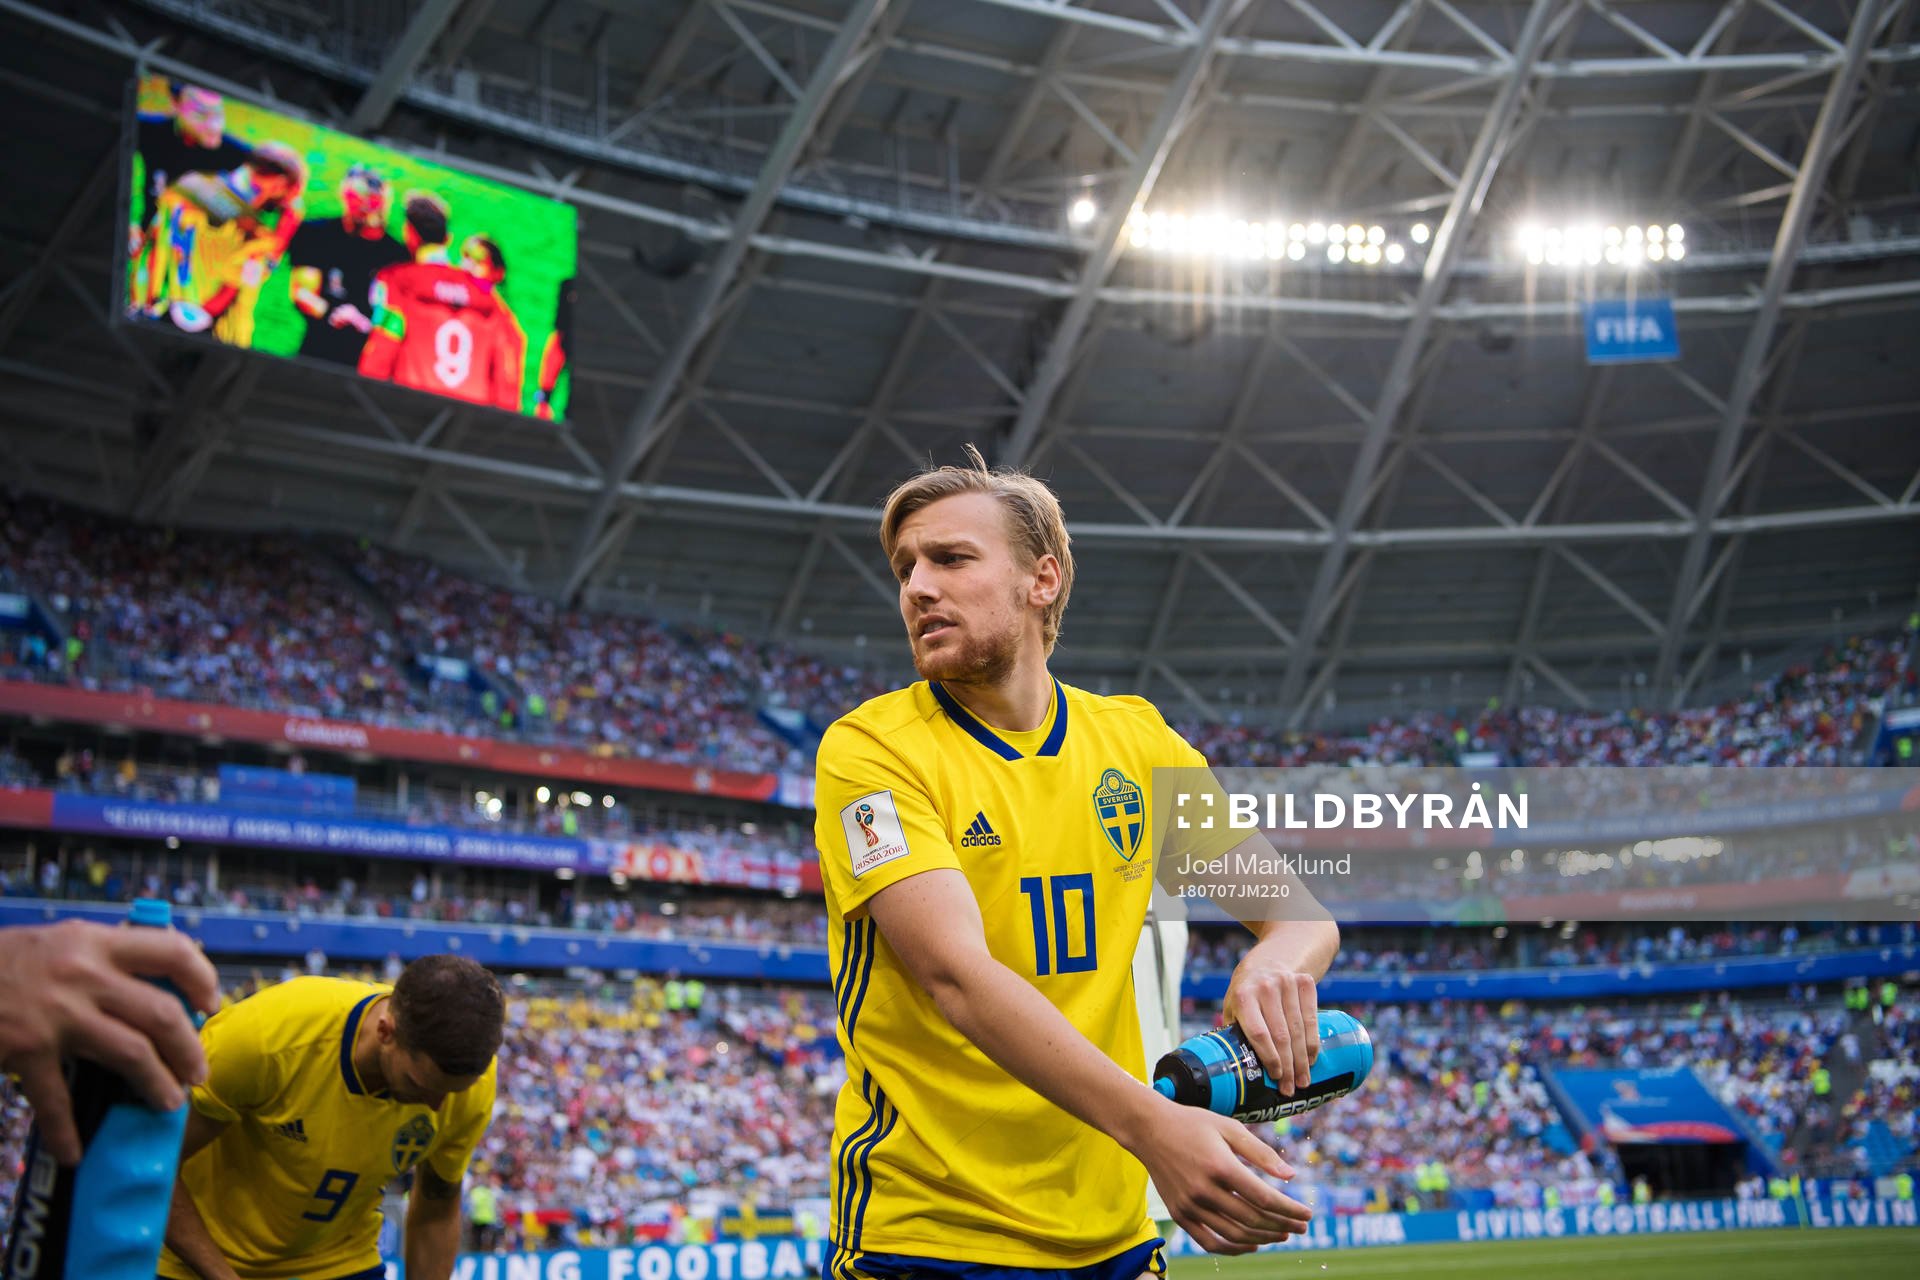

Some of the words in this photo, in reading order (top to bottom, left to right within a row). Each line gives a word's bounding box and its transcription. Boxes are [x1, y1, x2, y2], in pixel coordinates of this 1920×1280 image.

[1595, 315, 1664, 344] FIFA
[1102, 793, 1133, 805] SVERIGE
[855, 852, 884, 871] RUSSIA
[883, 844, 904, 858] 2018
[960, 833, 1002, 848] adidas
[1019, 872, 1098, 976] 10
[302, 1168, 360, 1222] 9
[1456, 1207, 1566, 1242] LIVING
[1574, 1200, 1720, 1236] FOOTBALL
[607, 1239, 823, 1280] FOOTBAL
